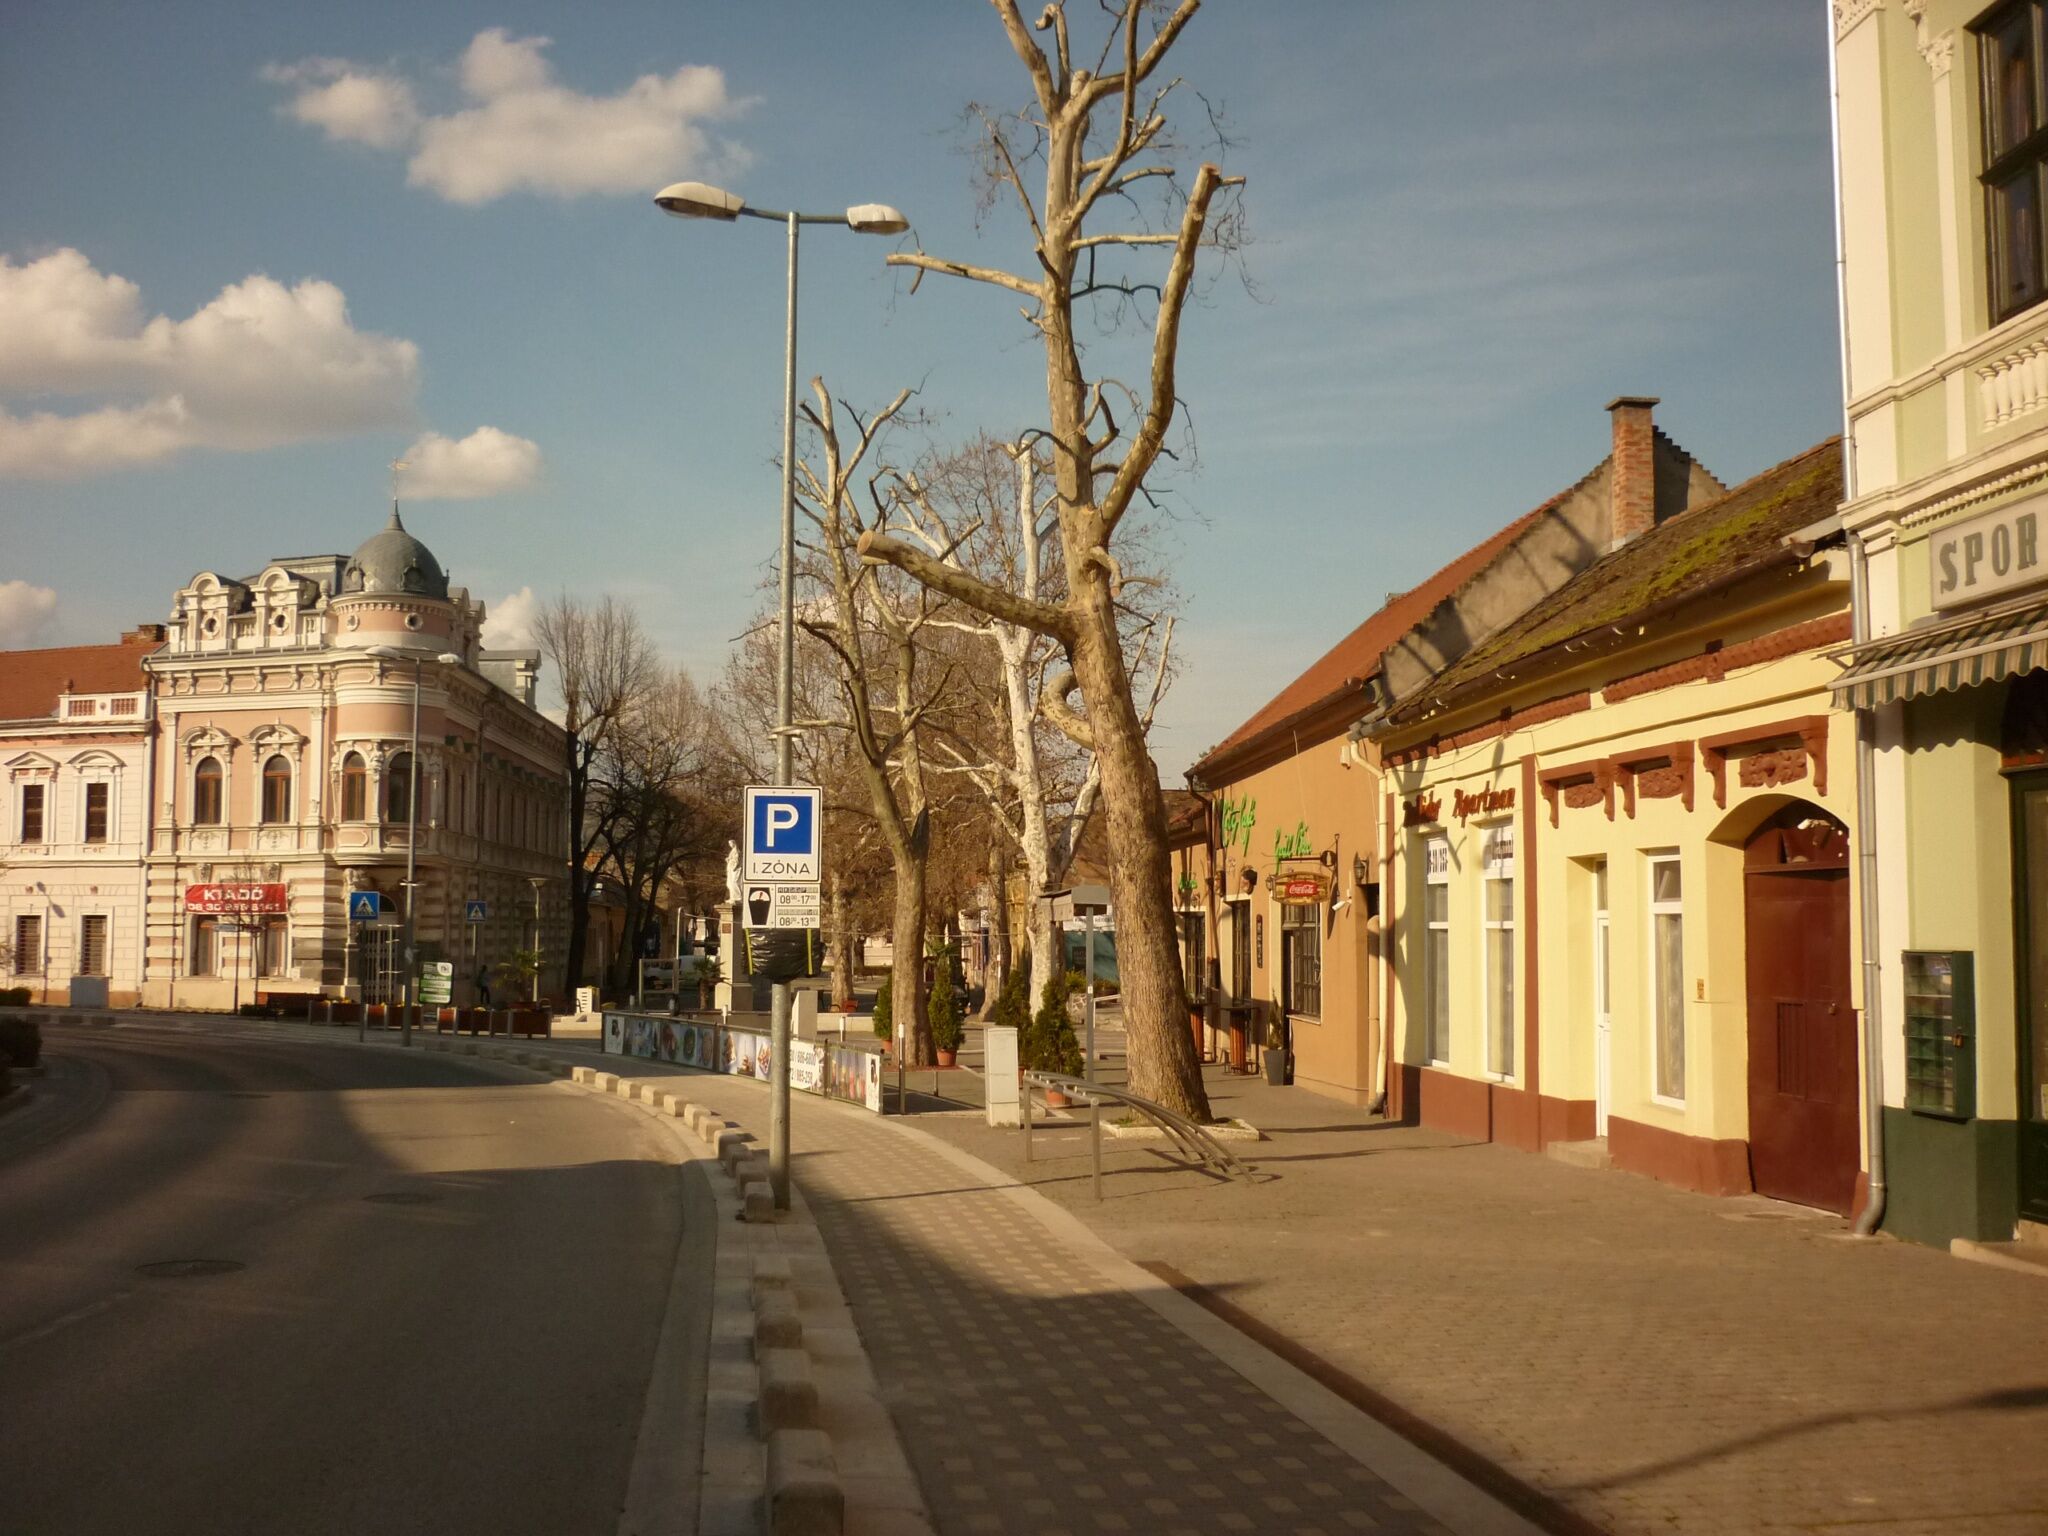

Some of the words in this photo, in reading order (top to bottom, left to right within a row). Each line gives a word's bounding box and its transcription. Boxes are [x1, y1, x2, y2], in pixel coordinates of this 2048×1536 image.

[1939, 512, 2038, 595] SPOR
[766, 803, 799, 847] P
[761, 859, 811, 874] ZÓNA
[203, 886, 264, 901] KIADÓ
